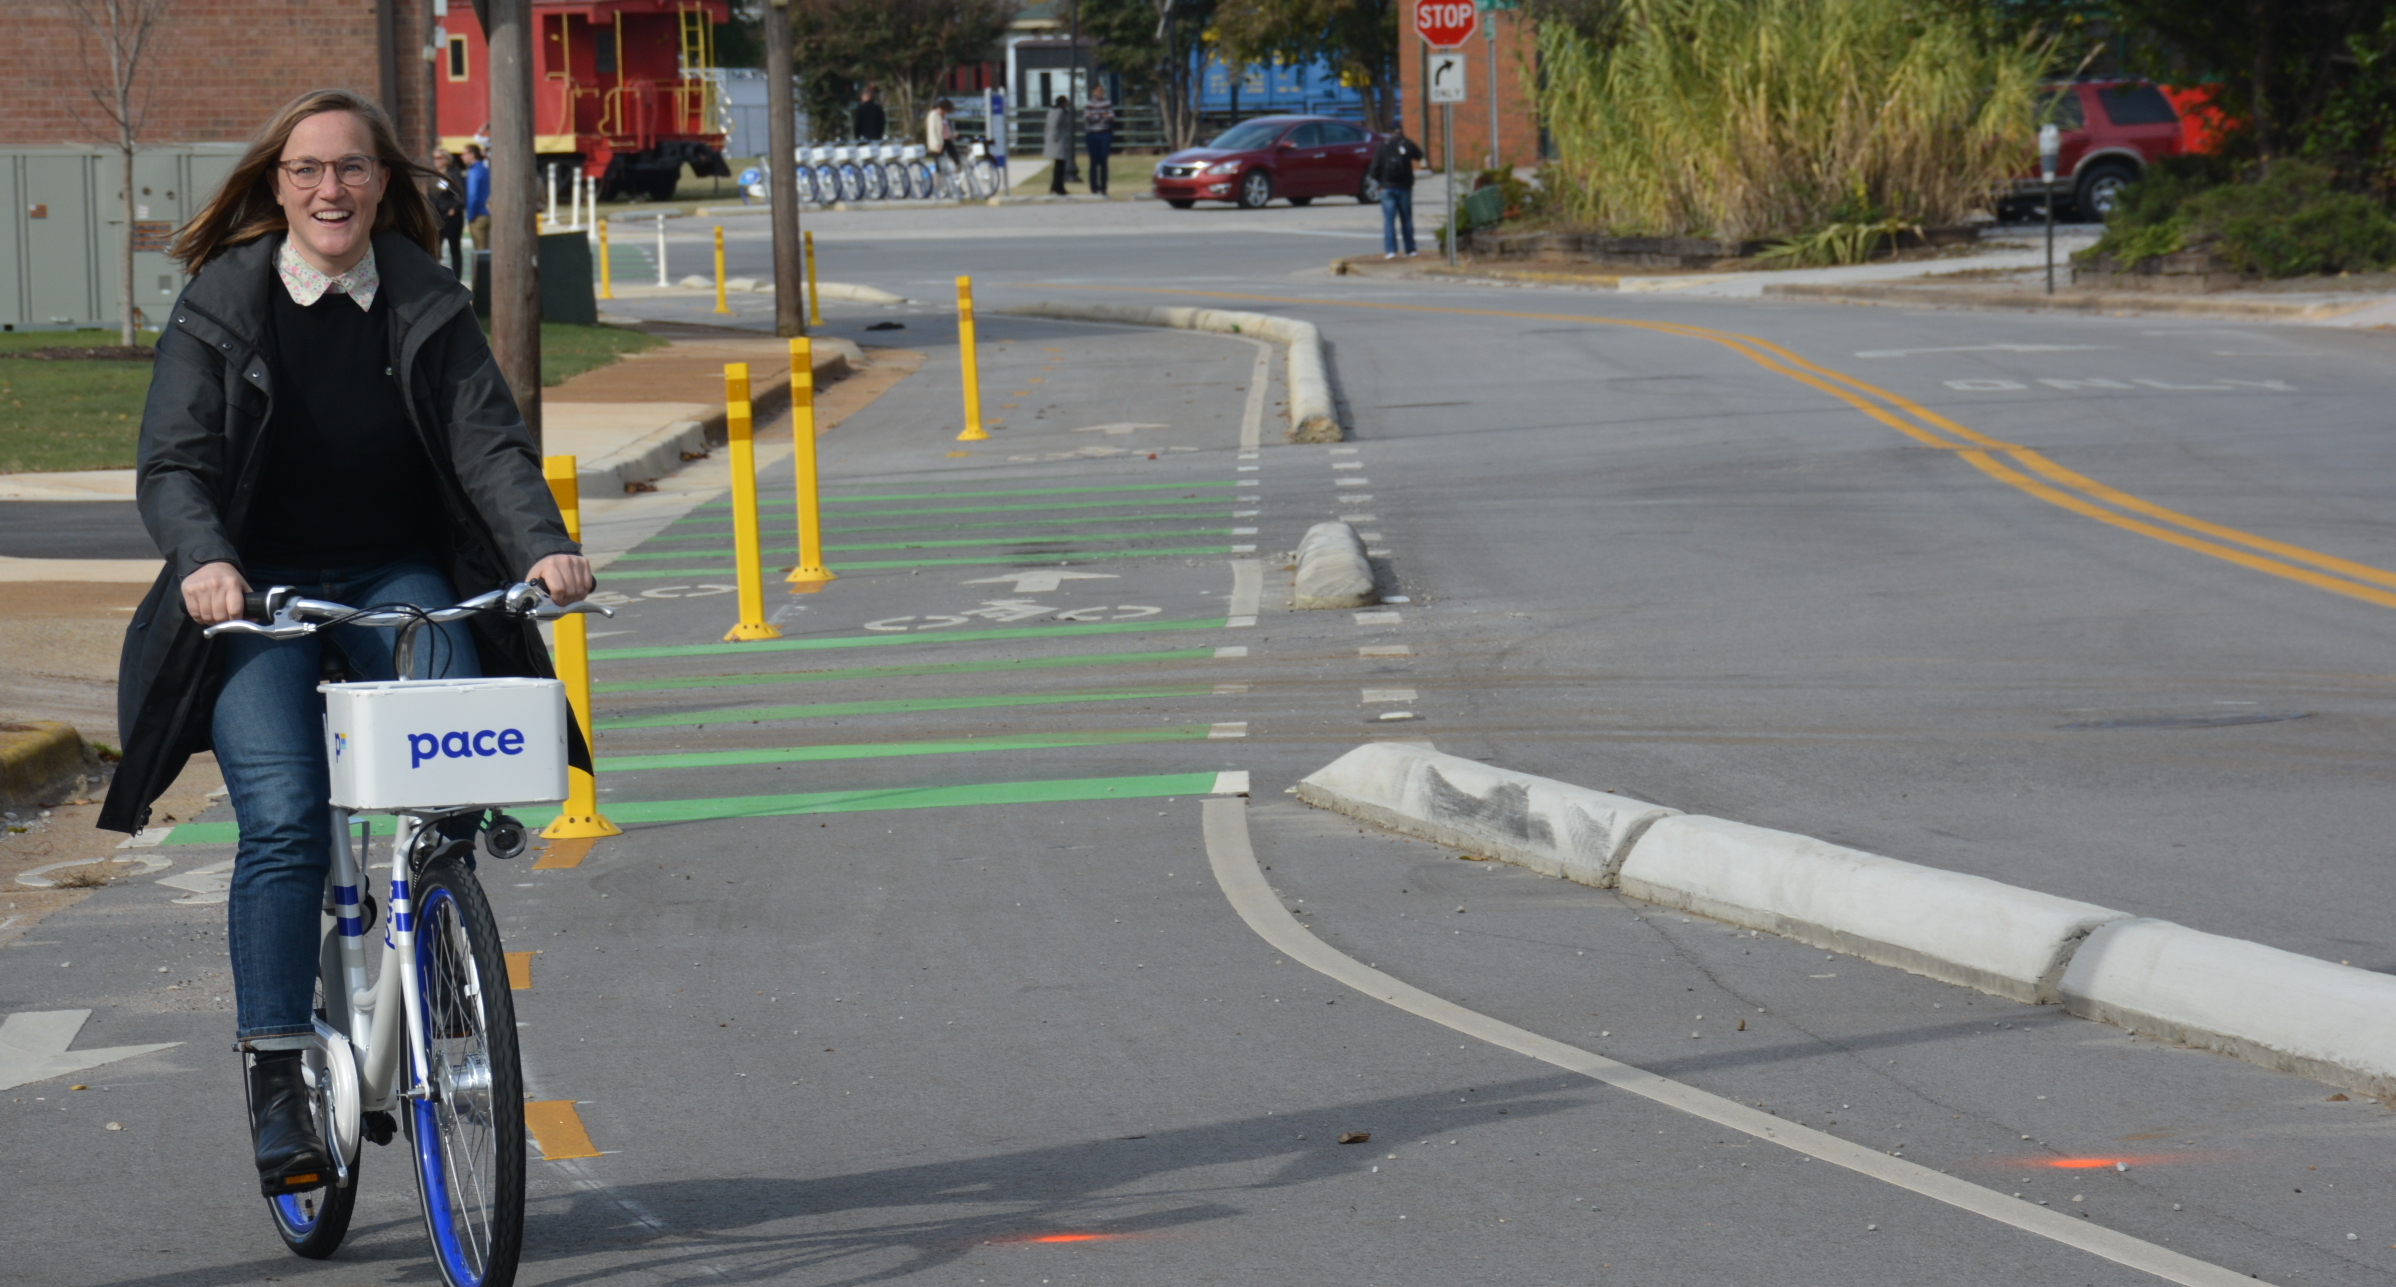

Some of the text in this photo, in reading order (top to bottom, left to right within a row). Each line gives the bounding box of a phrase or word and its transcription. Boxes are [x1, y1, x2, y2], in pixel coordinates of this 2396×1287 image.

[1419, 5, 1472, 28] STOP
[1434, 90, 1460, 98] ONLY
[1943, 378, 2297, 391] ONLY
[407, 728, 525, 769] pace
